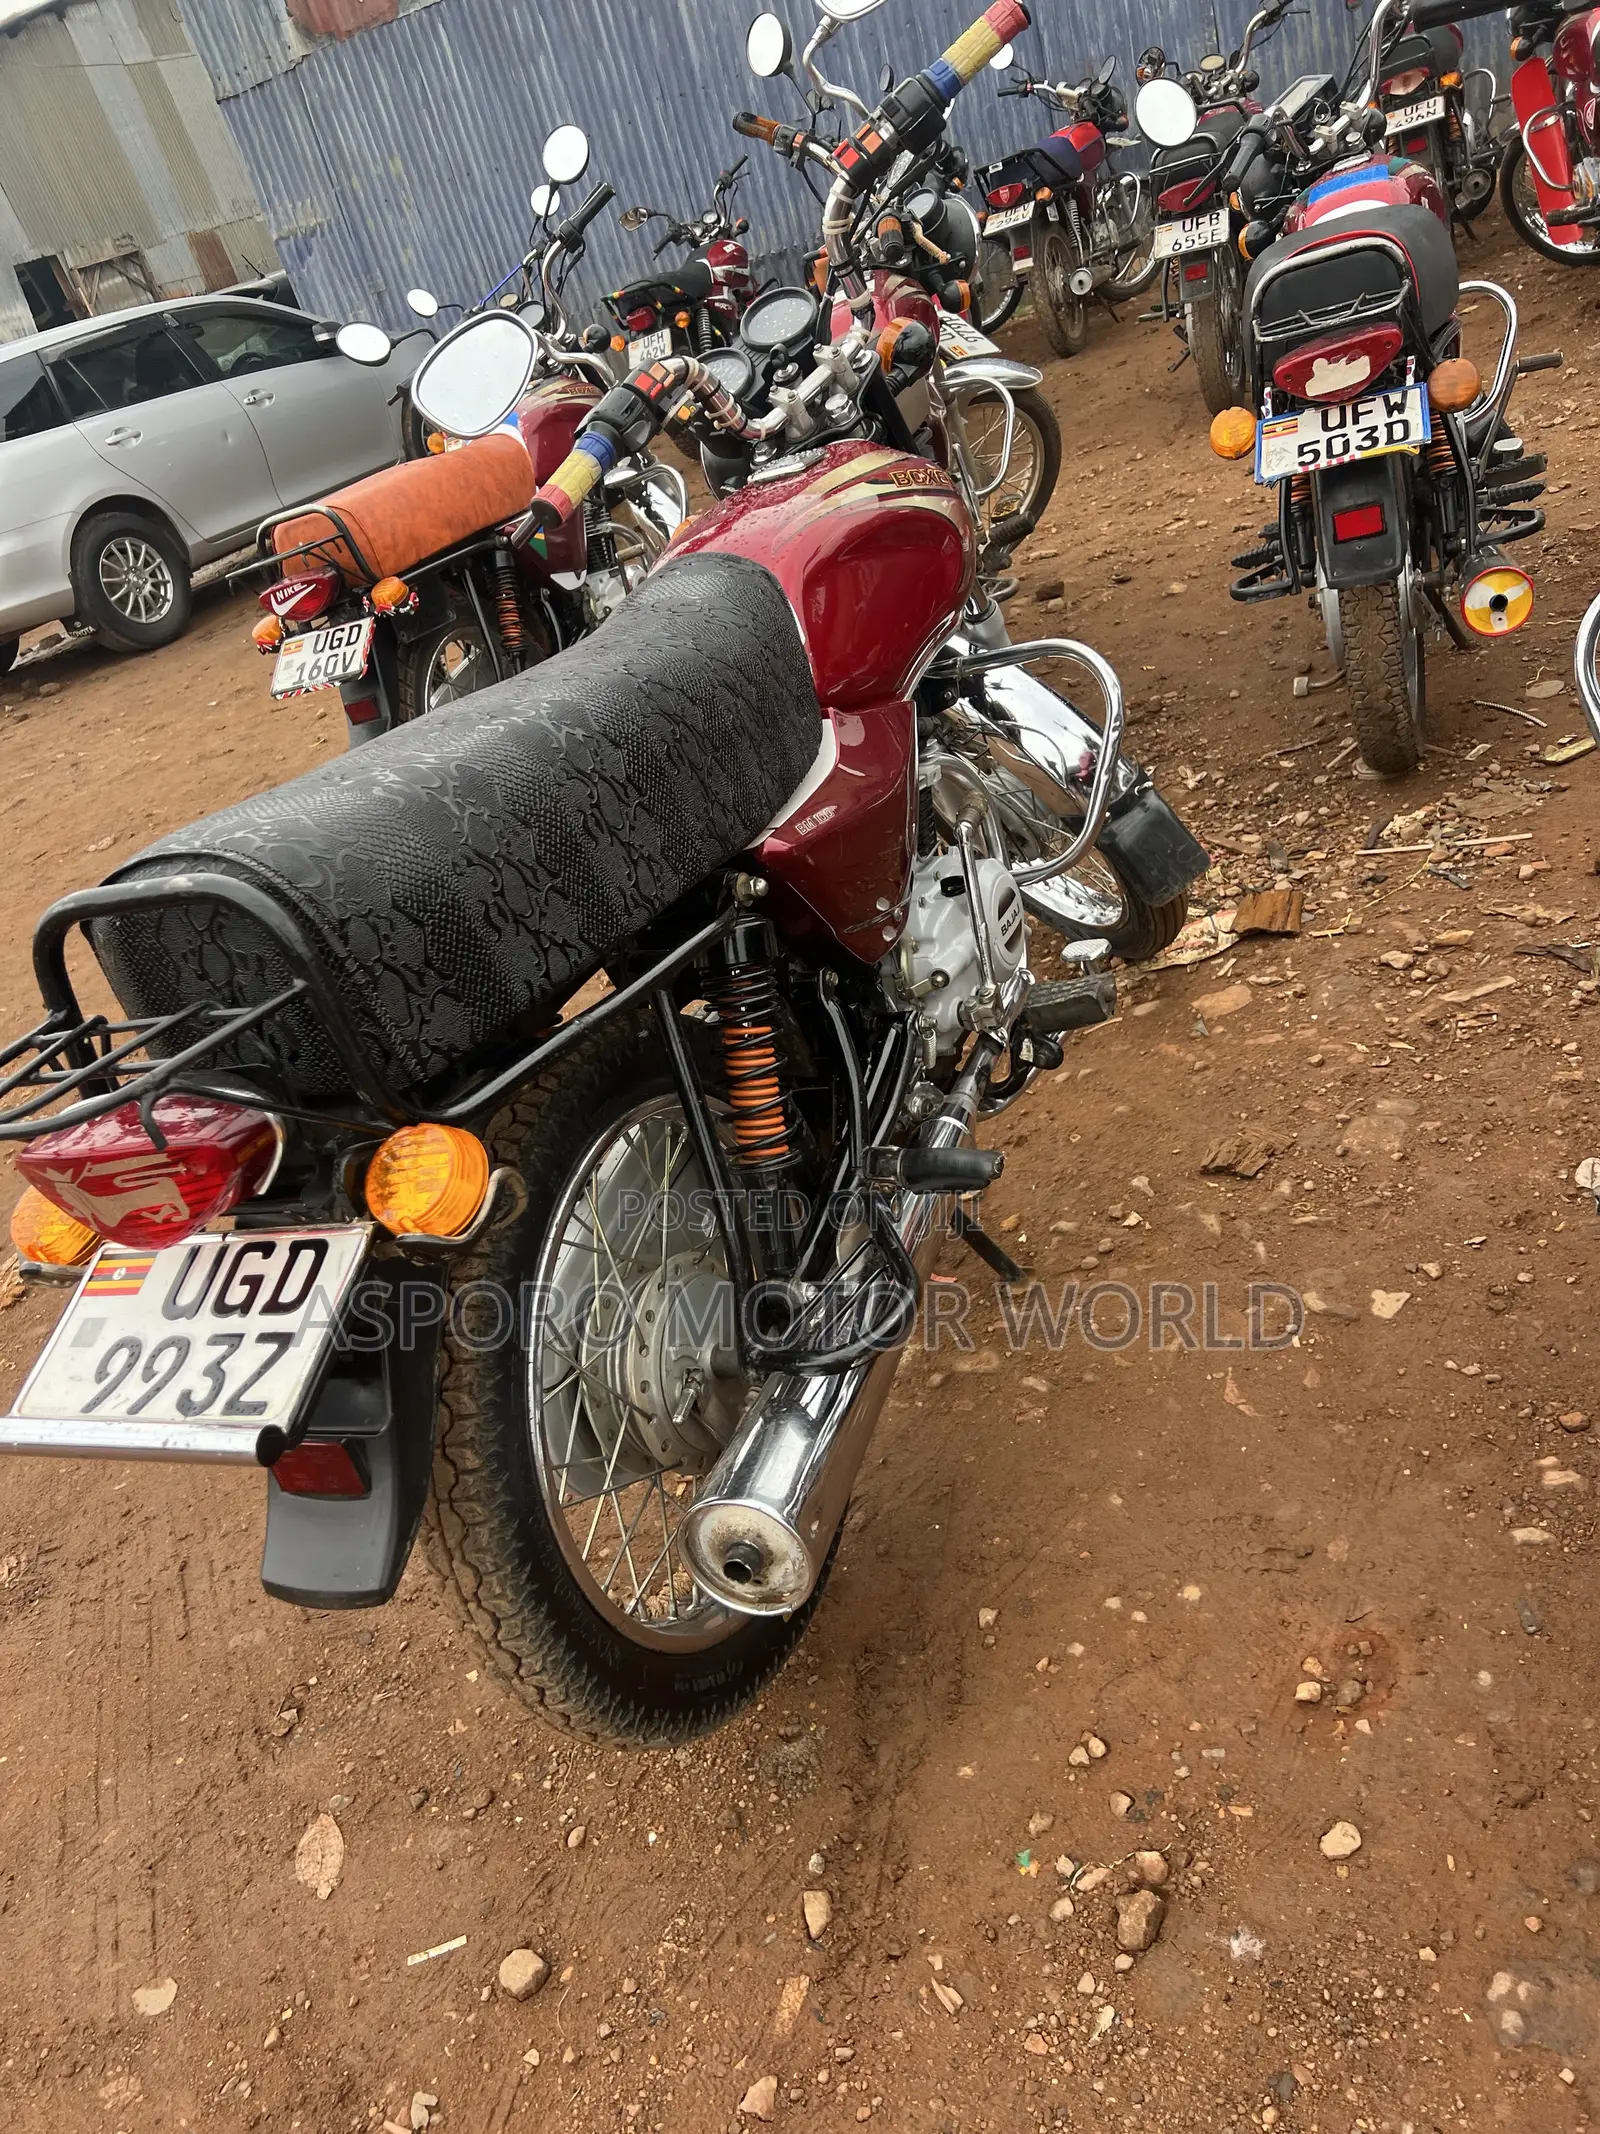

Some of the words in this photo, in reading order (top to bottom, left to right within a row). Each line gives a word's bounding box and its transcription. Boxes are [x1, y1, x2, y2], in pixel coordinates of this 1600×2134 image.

[1404, 98, 1437, 117] UFU
[1181, 211, 1221, 233] UFB
[1171, 228, 1222, 252] 655E
[643, 331, 665, 349] UFH
[1320, 388, 1409, 433] UFW
[1297, 418, 1411, 468] 503D
[275, 582, 308, 603] NIKE
[312, 623, 363, 655] UGD
[291, 649, 358, 687] 160V
[1000, 903, 1020, 937] BAJAJ
[161, 1237, 331, 1321] UGD
[79, 1331, 296, 1418] 993Z
